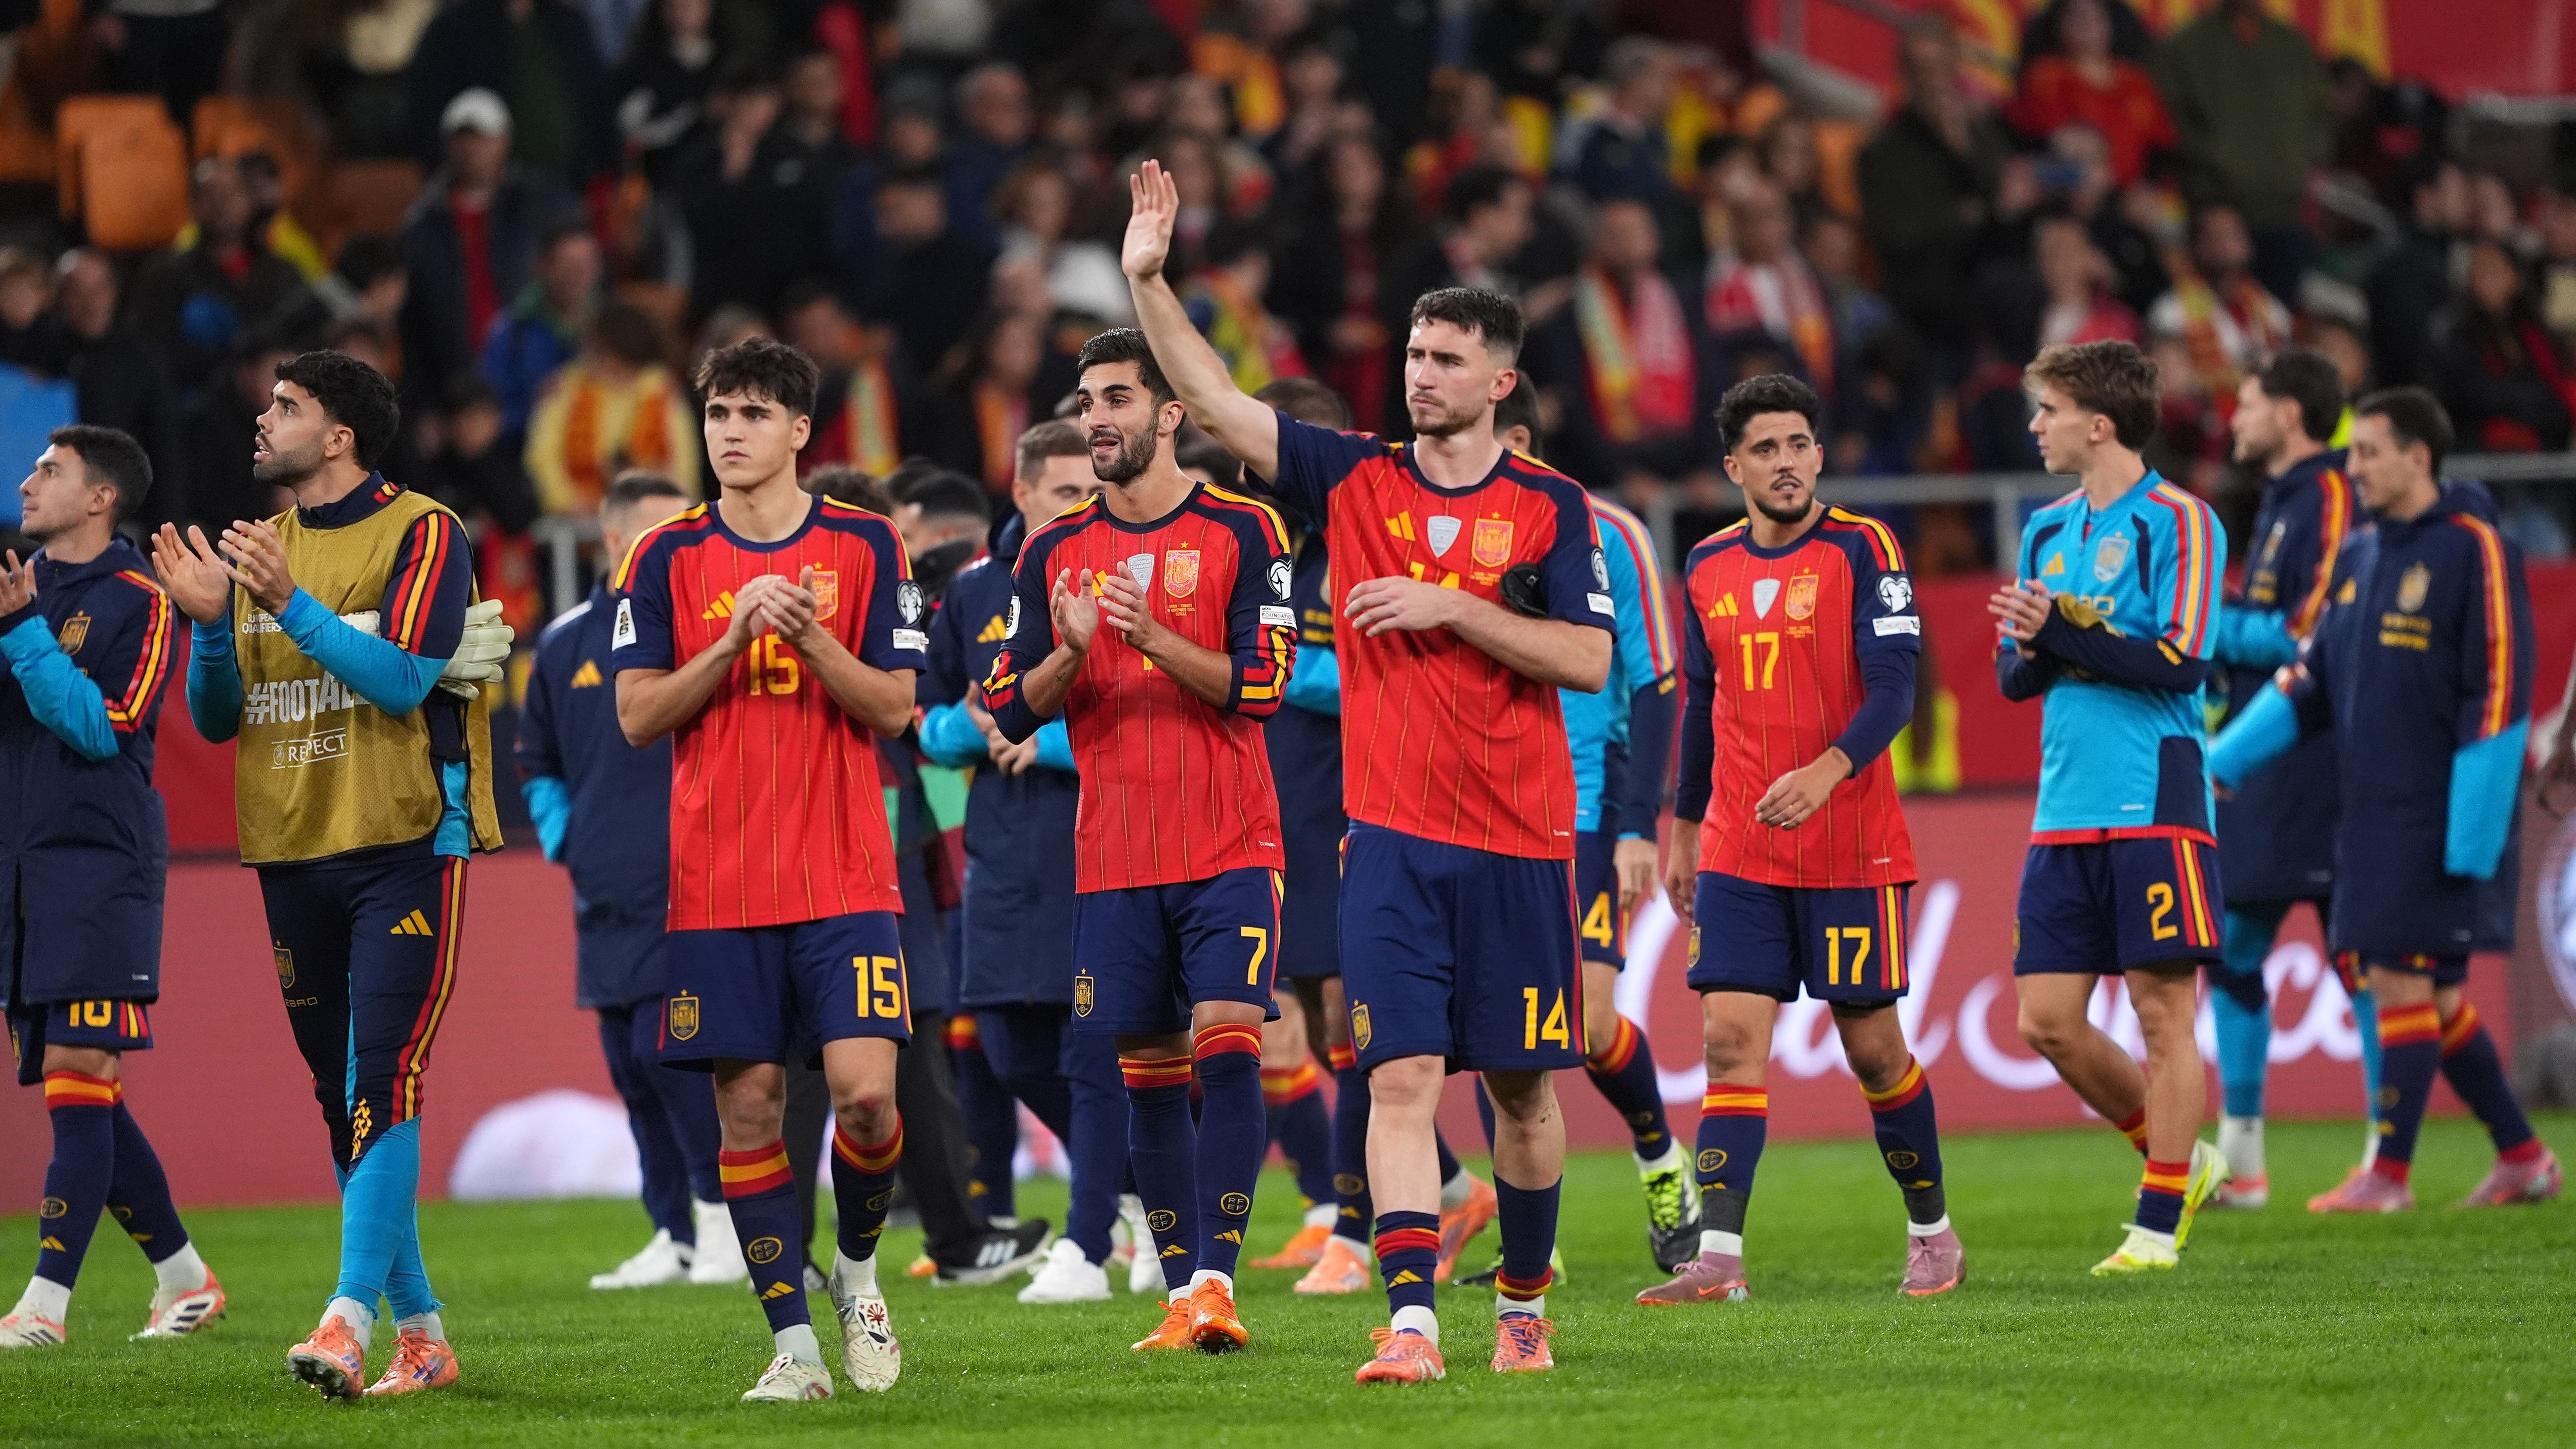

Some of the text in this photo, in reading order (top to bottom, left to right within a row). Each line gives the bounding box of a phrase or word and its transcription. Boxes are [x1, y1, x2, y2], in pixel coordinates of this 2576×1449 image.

[750, 634, 799, 695] 15
[1740, 632, 1779, 691] 17
[2148, 883, 2178, 941] 2
[1241, 927, 1267, 986] 7
[1825, 928, 1870, 985] 17
[853, 956, 901, 1018] 15
[1523, 987, 1569, 1050] 14
